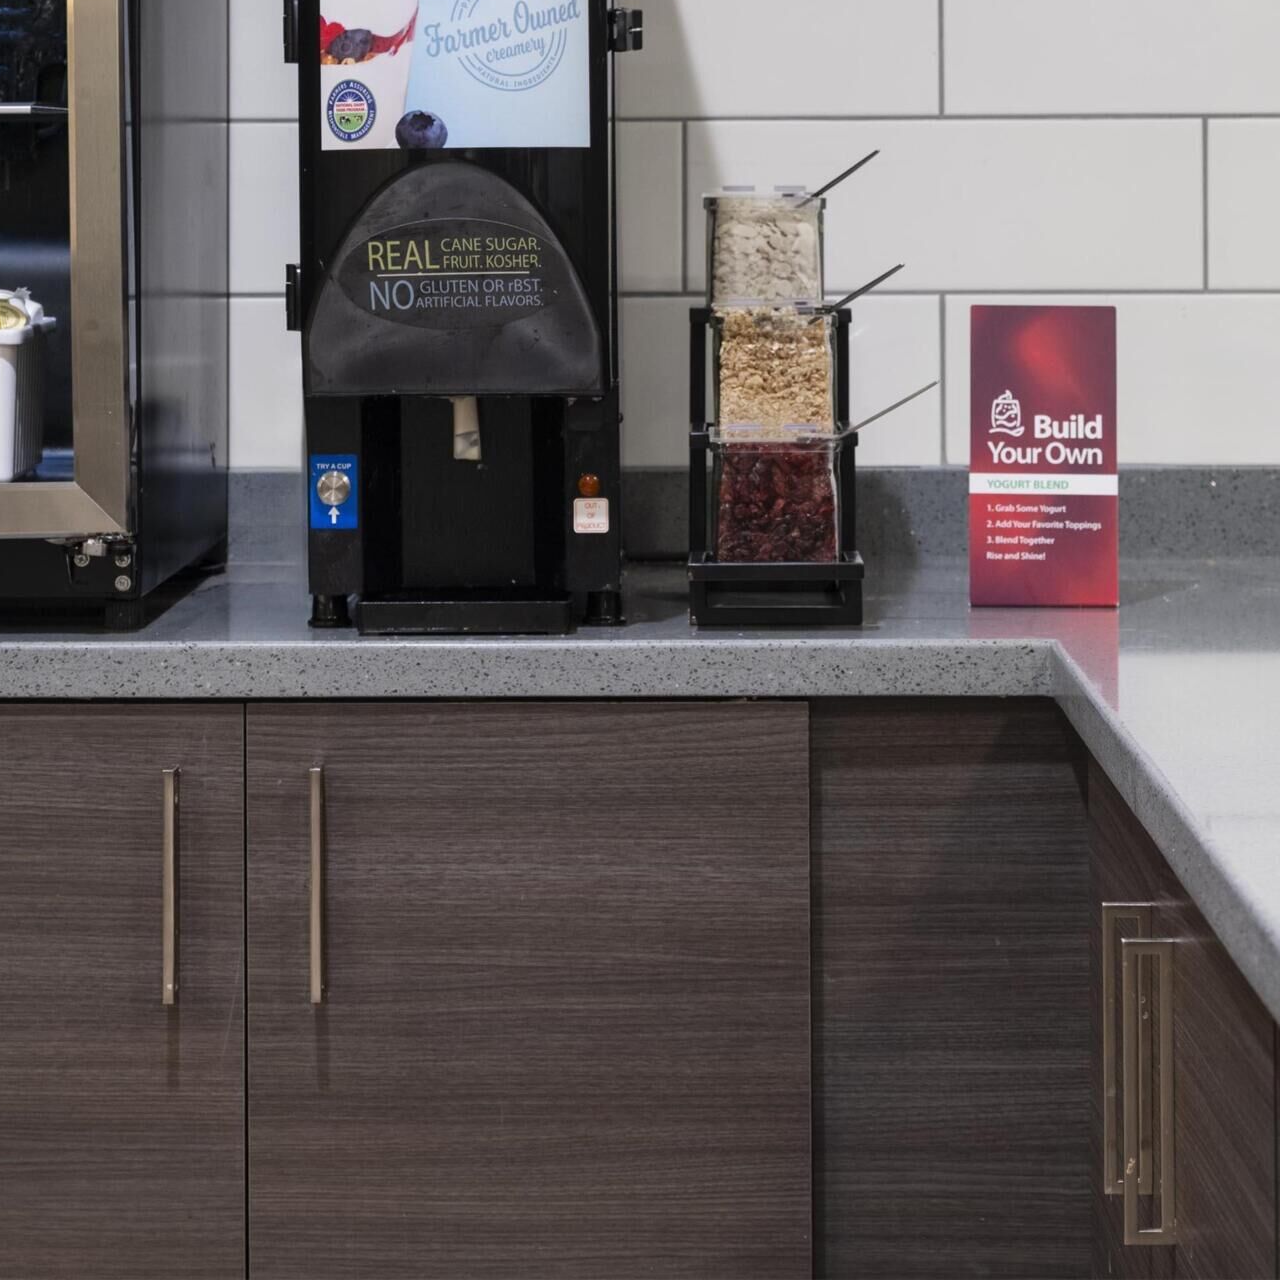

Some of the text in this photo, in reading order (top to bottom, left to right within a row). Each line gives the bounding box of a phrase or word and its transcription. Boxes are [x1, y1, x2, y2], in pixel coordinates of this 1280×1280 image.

[423, 18, 514, 58] Farmer
[486, 37, 546, 63] creamery
[440, 237, 541, 252] CANE SUGAR.
[367, 240, 440, 271] REAL
[443, 254, 542, 269] FRUIT. KOSHER.
[420, 278, 543, 294] GLUTEN OR rBST.
[370, 280, 415, 311] NO
[416, 294, 544, 309] ARTIFICIAL FLAVORS.
[1034, 414, 1102, 439] Build
[987, 441, 1103, 464] Your Own
[987, 479, 1069, 490] YOGURT BLEND
[987, 504, 1067, 514] 1. Grab Some Yogurt
[986, 520, 1102, 531] 2. Add Your Favorite Toppings
[986, 536, 1055, 546] 3. Blend Together
[986, 552, 1046, 561] Rise and Shine!
